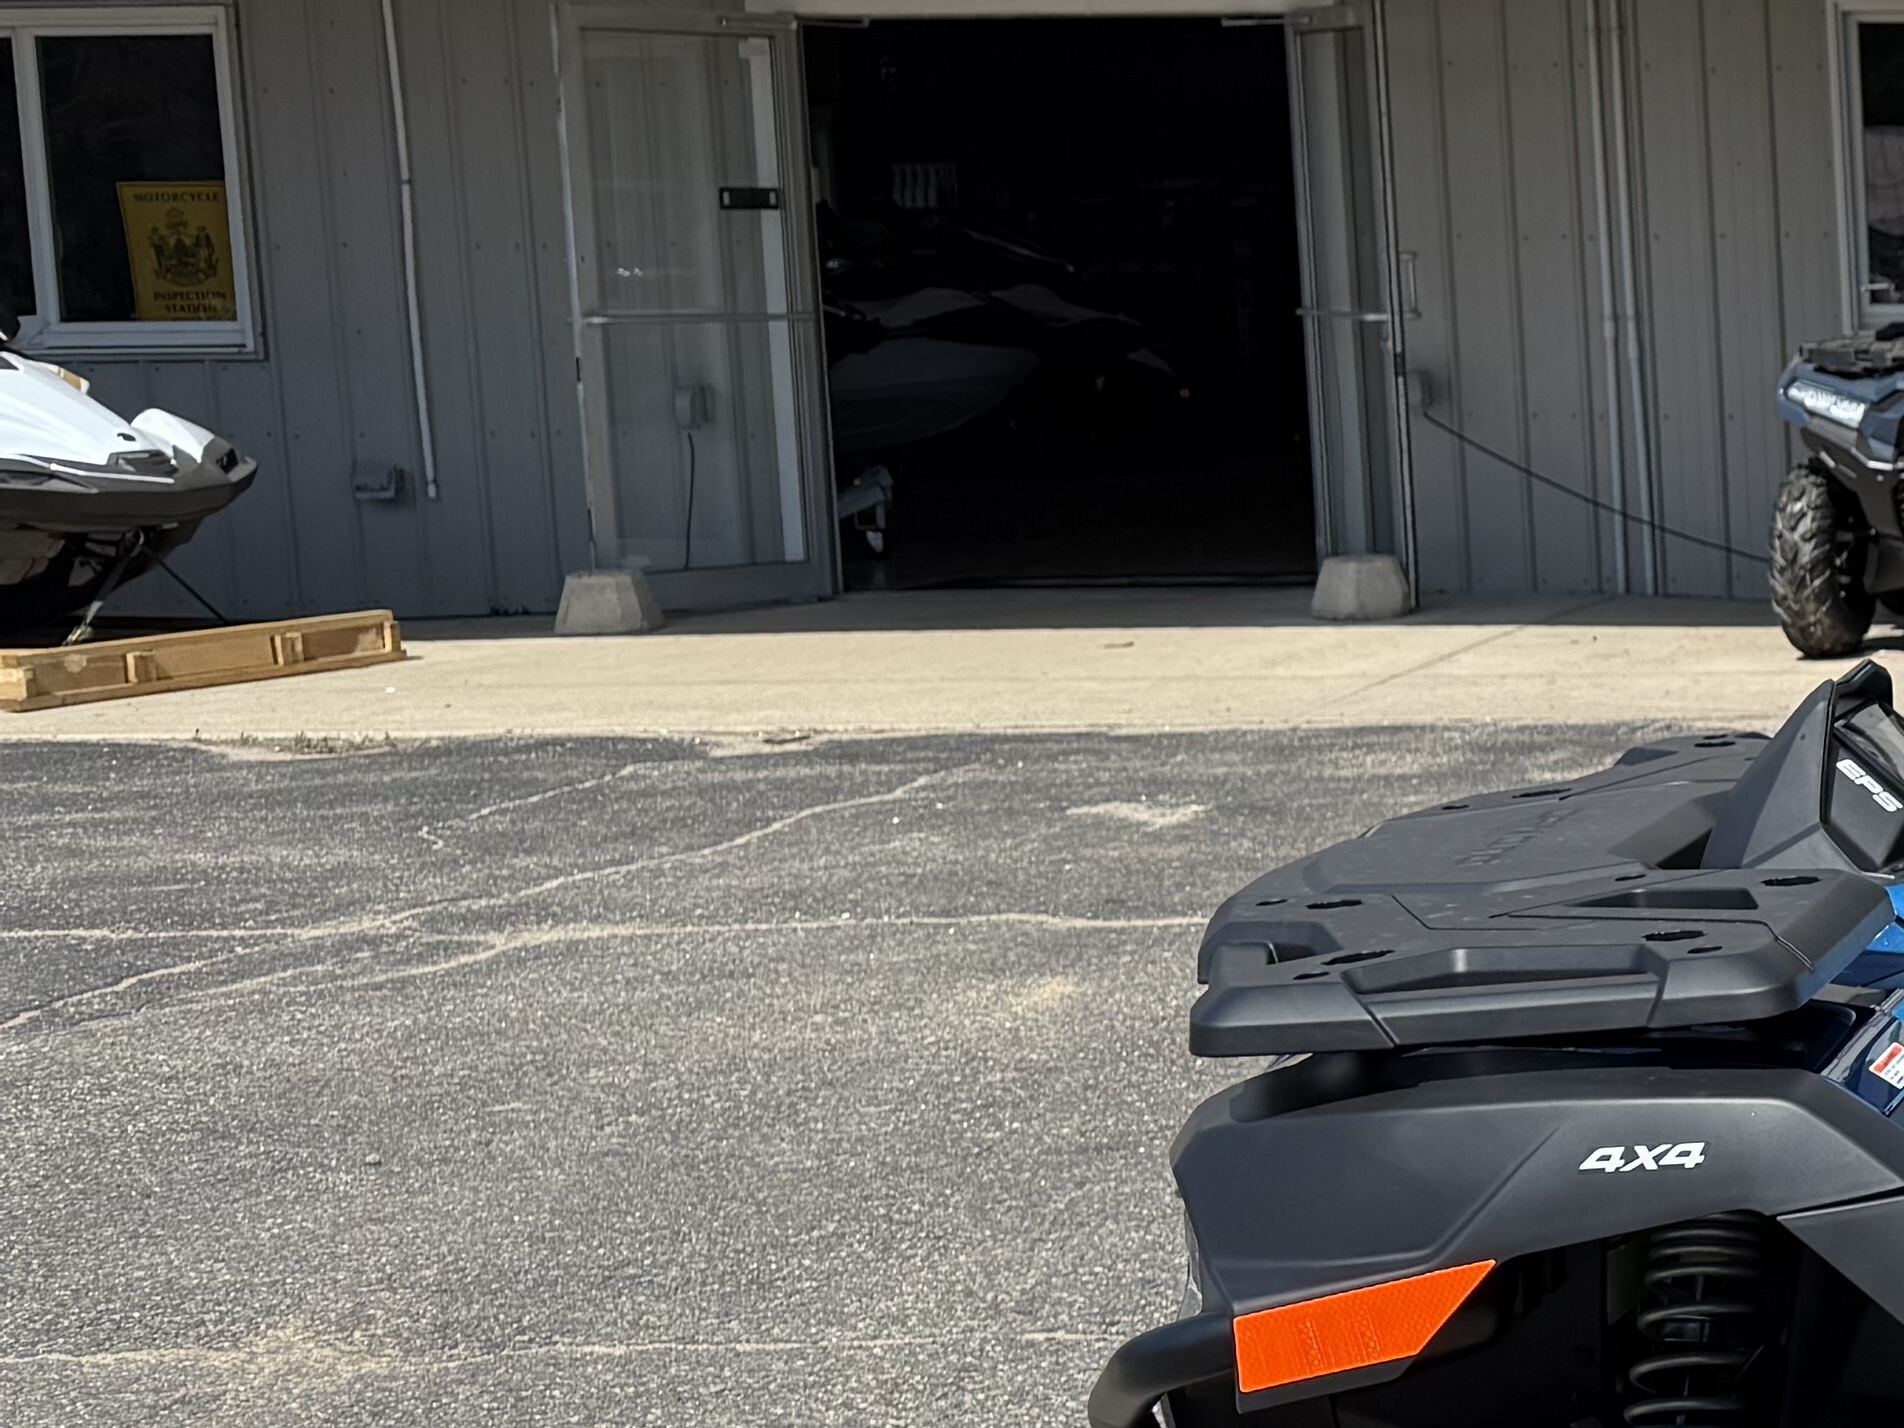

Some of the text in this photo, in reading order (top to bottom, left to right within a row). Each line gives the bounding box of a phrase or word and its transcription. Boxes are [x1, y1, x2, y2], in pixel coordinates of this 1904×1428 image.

[132, 191, 221, 202] MOTORCYCLE
[153, 290, 227, 301] INSPECTION
[165, 303, 219, 313] STATION
[1836, 758, 1904, 813] EPS
[1579, 1141, 1706, 1173] 4X4
